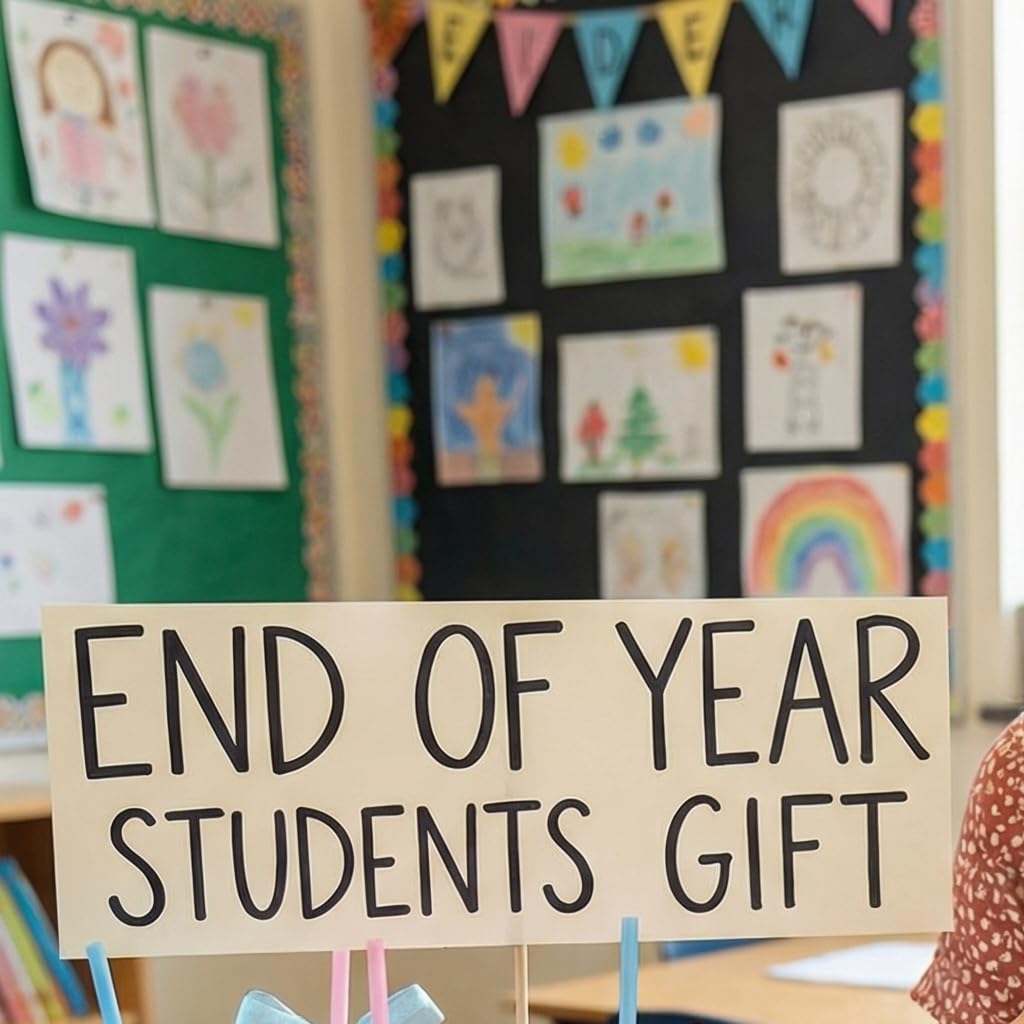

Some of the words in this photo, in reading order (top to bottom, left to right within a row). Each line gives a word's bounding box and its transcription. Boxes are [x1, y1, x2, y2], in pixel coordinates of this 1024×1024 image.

[75, 625, 344, 779] END
[415, 621, 563, 770] OF
[616, 615, 929, 770] YEAR
[109, 799, 593, 926] STUDENTS
[666, 792, 907, 912] GIFT
